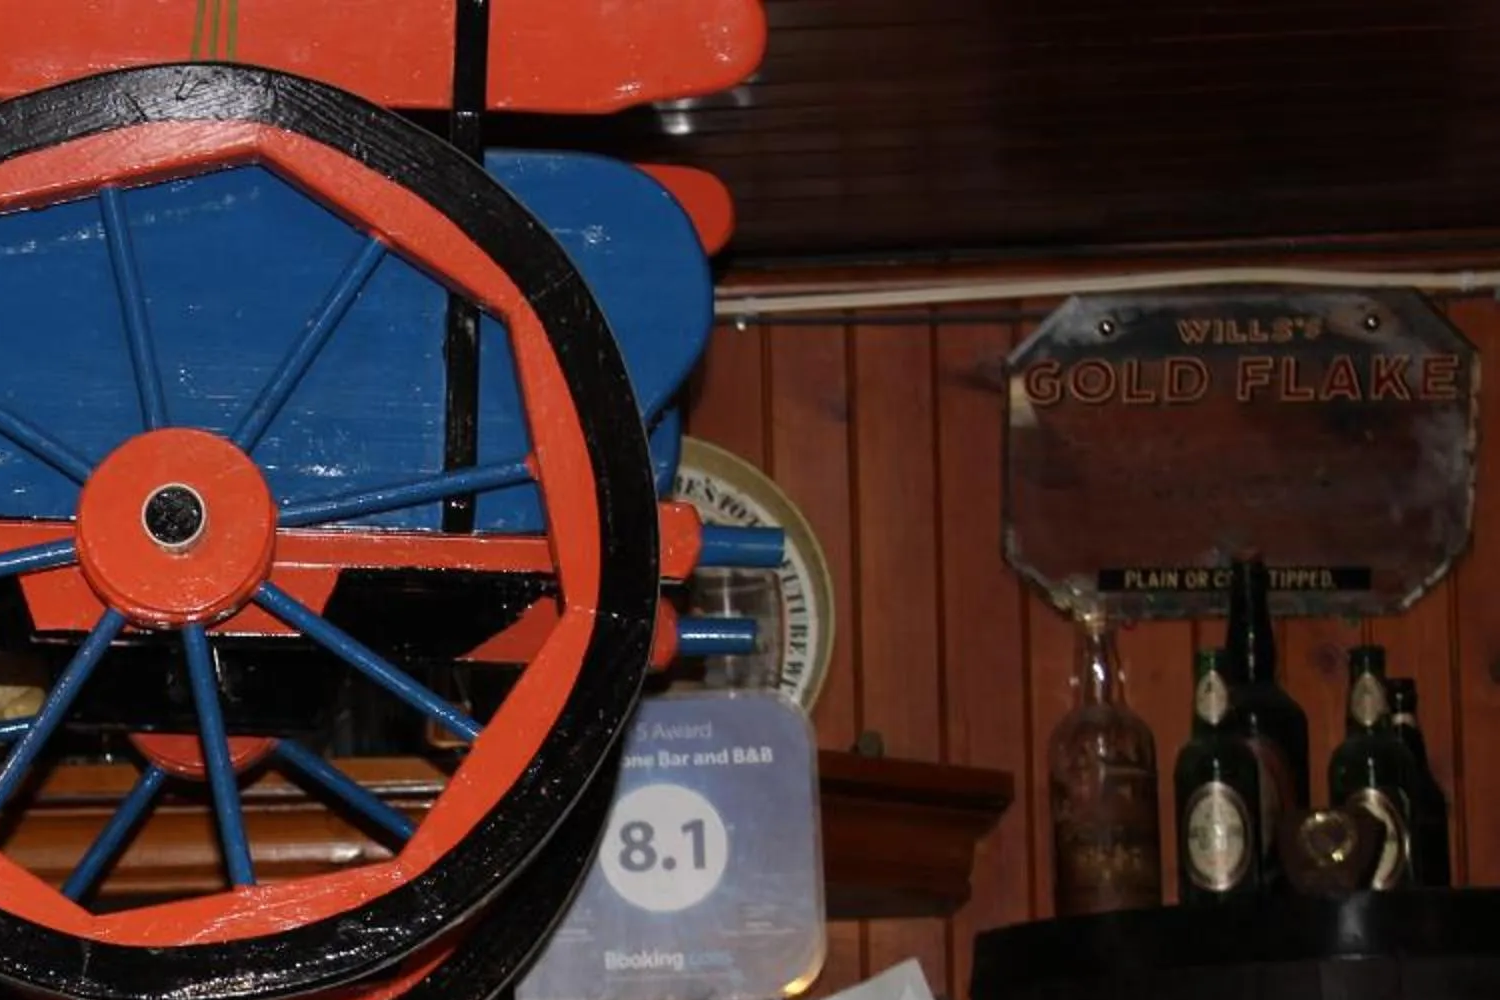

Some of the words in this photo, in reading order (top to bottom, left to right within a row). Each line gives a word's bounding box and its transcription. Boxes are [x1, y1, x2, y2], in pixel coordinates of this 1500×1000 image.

[1024, 356, 1211, 404] GOLD
[1236, 353, 1463, 402] FLAKE
[1123, 568, 1179, 589] PLAIN
[1183, 569, 1209, 588] OR
[651, 721, 713, 741] Award
[658, 750, 689, 768] Bar
[693, 749, 729, 766] and
[732, 746, 774, 764] B&B
[617, 817, 707, 874] 8.1
